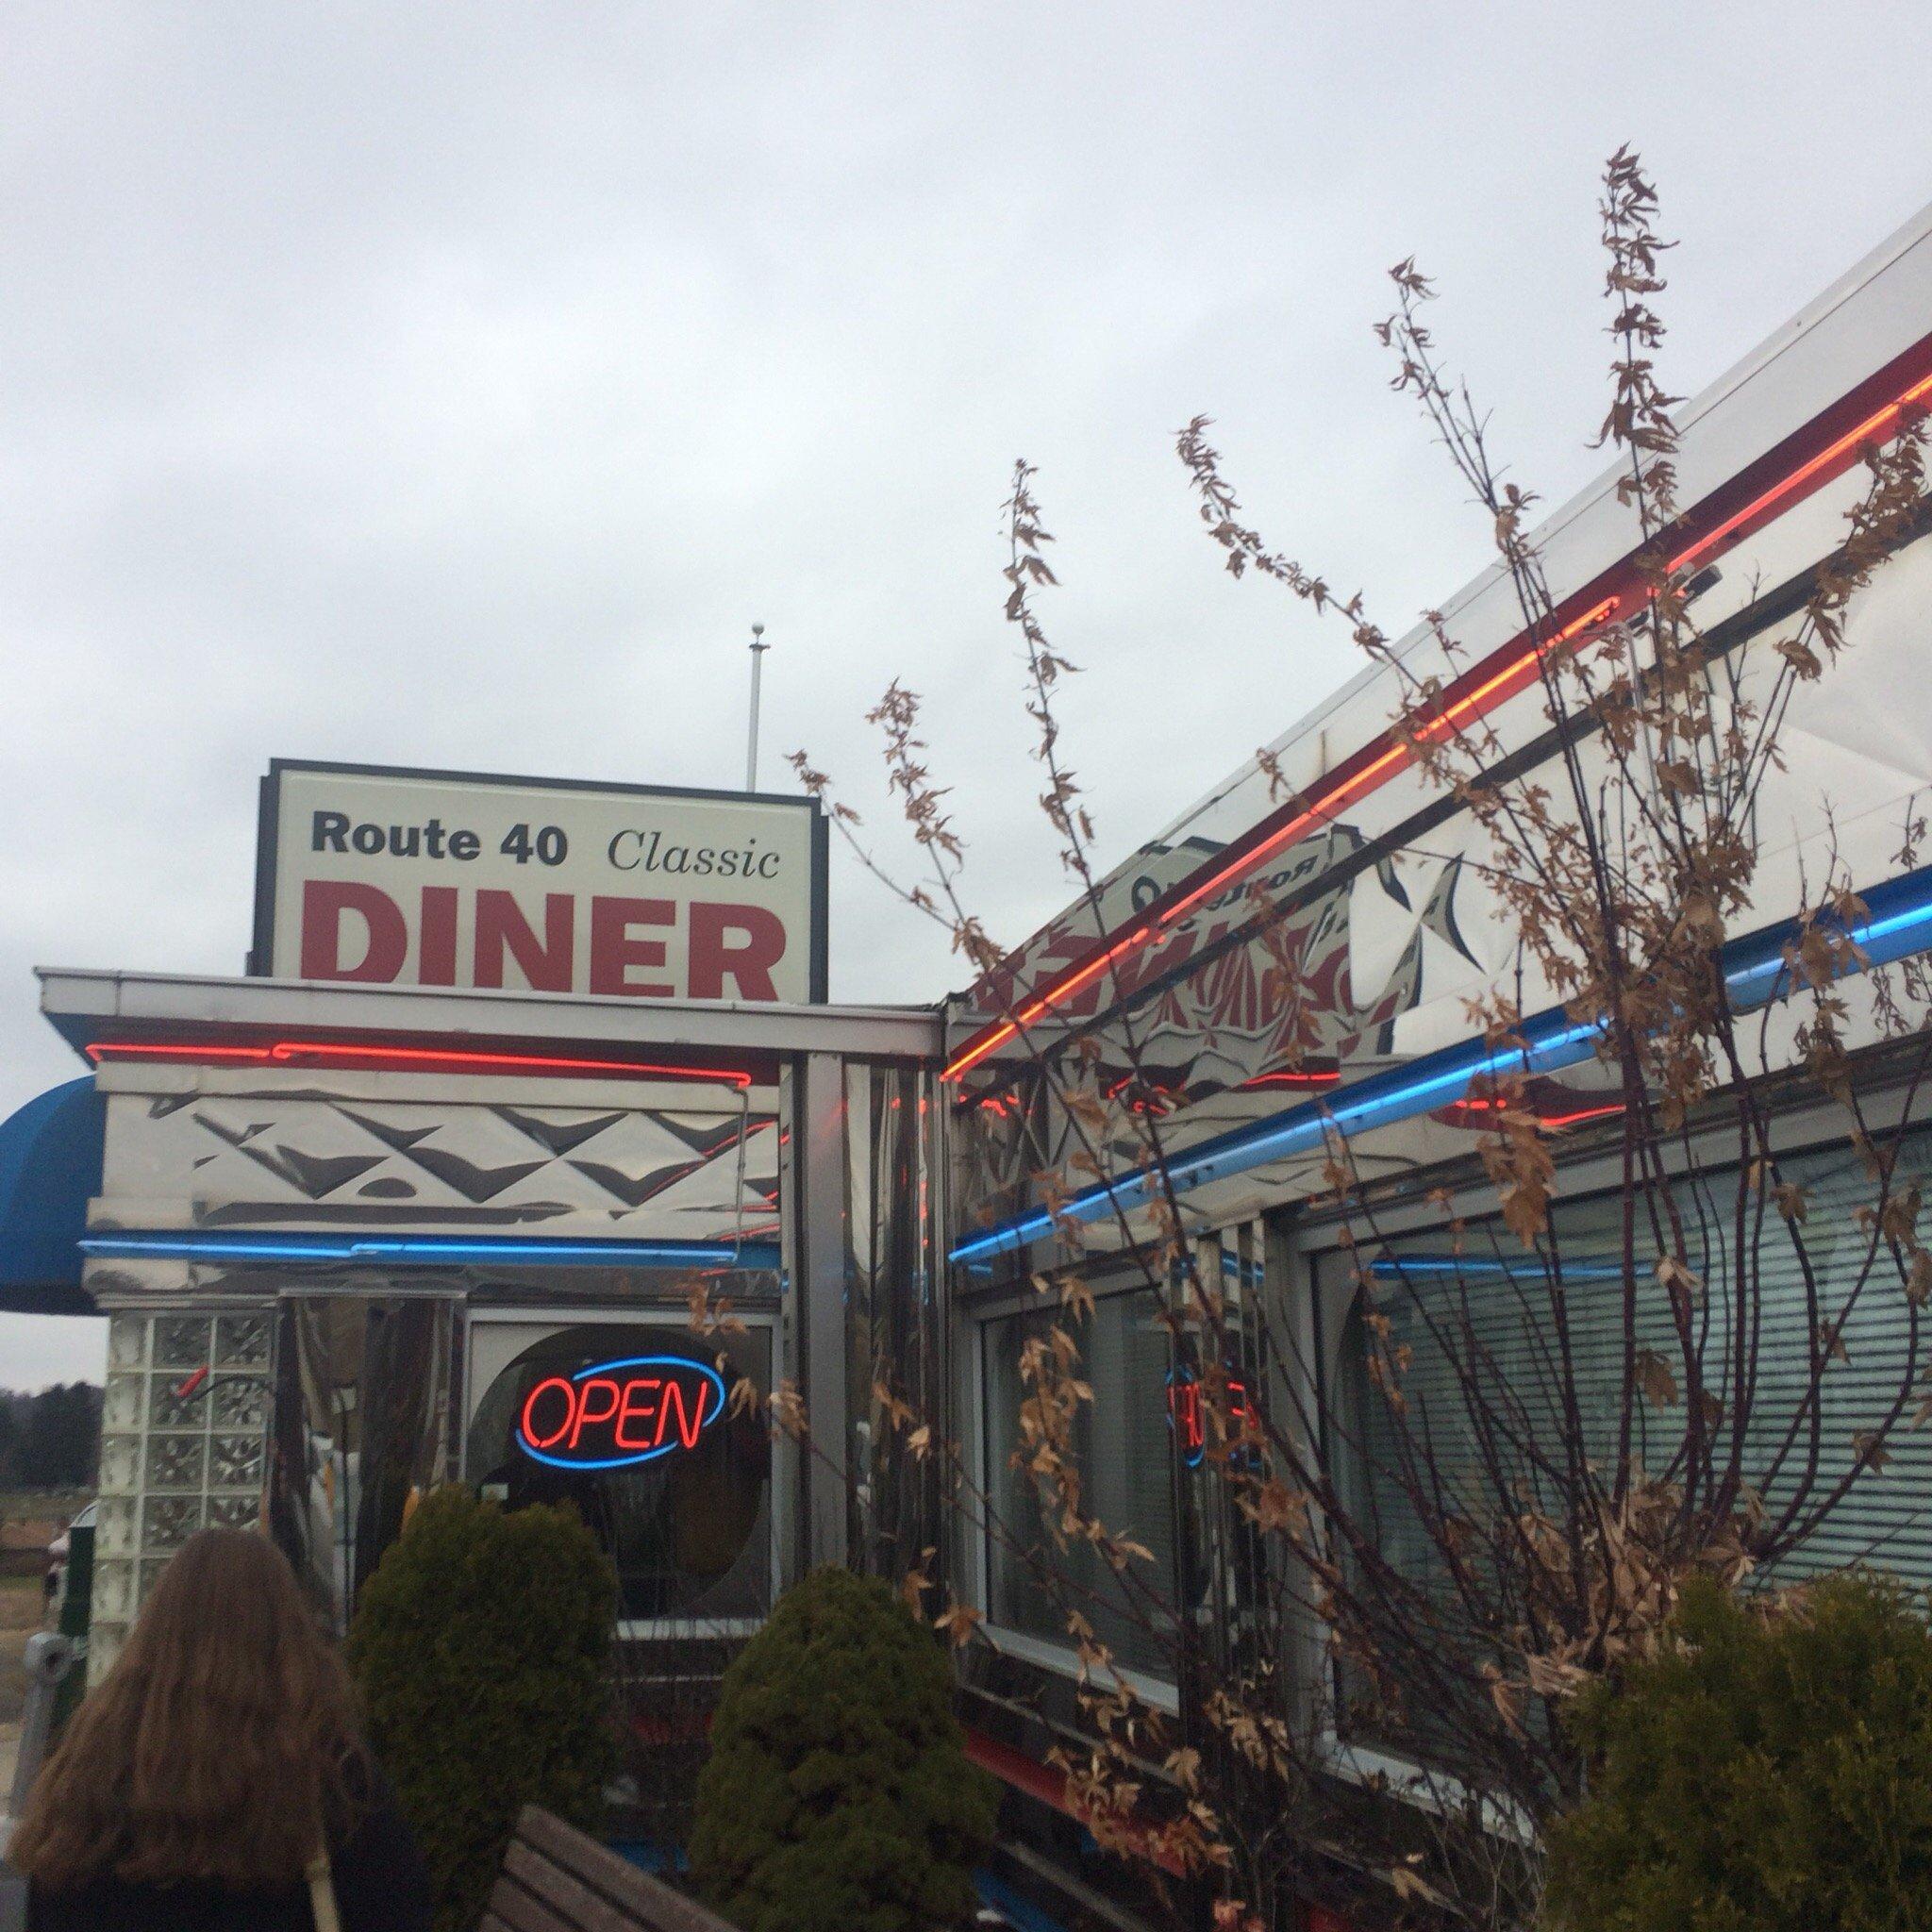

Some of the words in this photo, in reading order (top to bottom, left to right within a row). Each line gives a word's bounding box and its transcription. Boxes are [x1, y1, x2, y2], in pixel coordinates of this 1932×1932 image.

[312, 810, 481, 860] Route
[500, 824, 568, 866] 40
[608, 829, 780, 878] Classic
[300, 879, 787, 1002] DINER
[523, 1376, 708, 1449] OPEN
